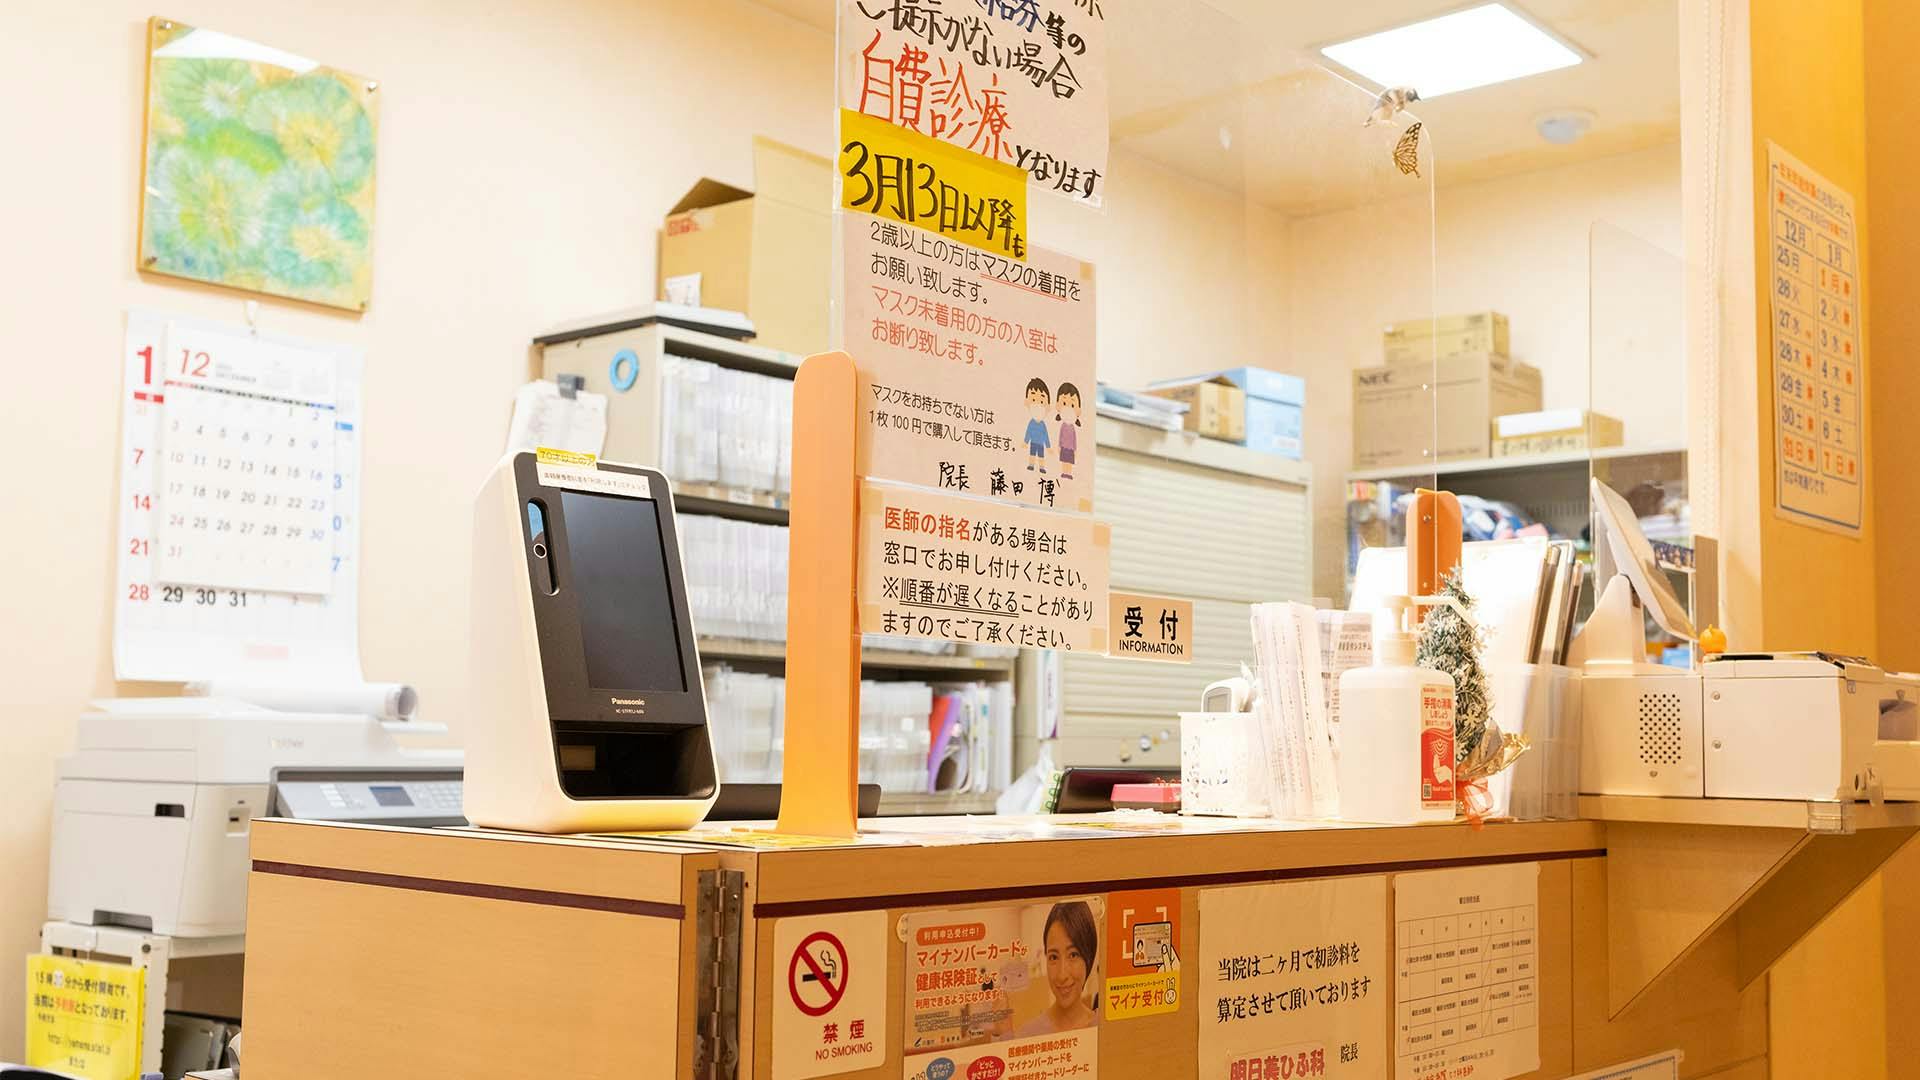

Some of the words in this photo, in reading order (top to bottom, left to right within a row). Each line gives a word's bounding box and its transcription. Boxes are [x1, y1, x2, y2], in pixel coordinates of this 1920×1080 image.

[859, 28, 1013, 160] 自費診療
[1015, 144, 1103, 199] となります
[870, 221, 1081, 302] 2歳以上の方はマスクの着用を
[871, 252, 988, 304] お願い致します。
[872, 285, 1058, 354] マスク未着用の方の入室は
[872, 317, 984, 366] お断り致します。
[137, 346, 153, 384] 1
[181, 349, 210, 378] 12
[870, 384, 996, 425] マスクをお持ちでない方は
[133, 448, 144, 464] 7
[217, 457, 232, 470] 12
[240, 460, 254, 473] 13
[264, 464, 277, 477] 14
[938, 461, 970, 490] 院長
[990, 468, 1024, 496] 藤田
[132, 494, 151, 511] 14
[193, 485, 207, 498] 18
[216, 488, 231, 501] 19
[241, 491, 256, 504] 20
[264, 494, 277, 506] 21
[216, 520, 232, 532] 26
[240, 522, 255, 535] 27
[263, 524, 278, 537] 28
[884, 506, 1067, 556] 医師の指名がある場合は
[130, 538, 149, 557] 21
[884, 541, 1089, 592] 窓口でお申し付けください。
[129, 584, 150, 601] 28
[163, 586, 184, 603] 29
[196, 588, 217, 606] 30
[229, 591, 248, 607] 31
[882, 610, 1072, 651] ますのでご了承ください。
[1119, 639, 1184, 656] INFORMATION
[611, 697, 645, 706] Panasonic
[916, 940, 1028, 967] マイナンバーカードが
[916, 967, 998, 992] 健康保険証として
[1110, 989, 1164, 1011] マイナ受付
[1217, 975, 1371, 1024] 算定させて頂いております
[815, 1046, 830, 1061] NO
[831, 1042, 873, 1058] SMOKING
[1008, 1052, 1072, 1072] マイナンバーカードを
[1340, 1042, 1359, 1064] 院長
